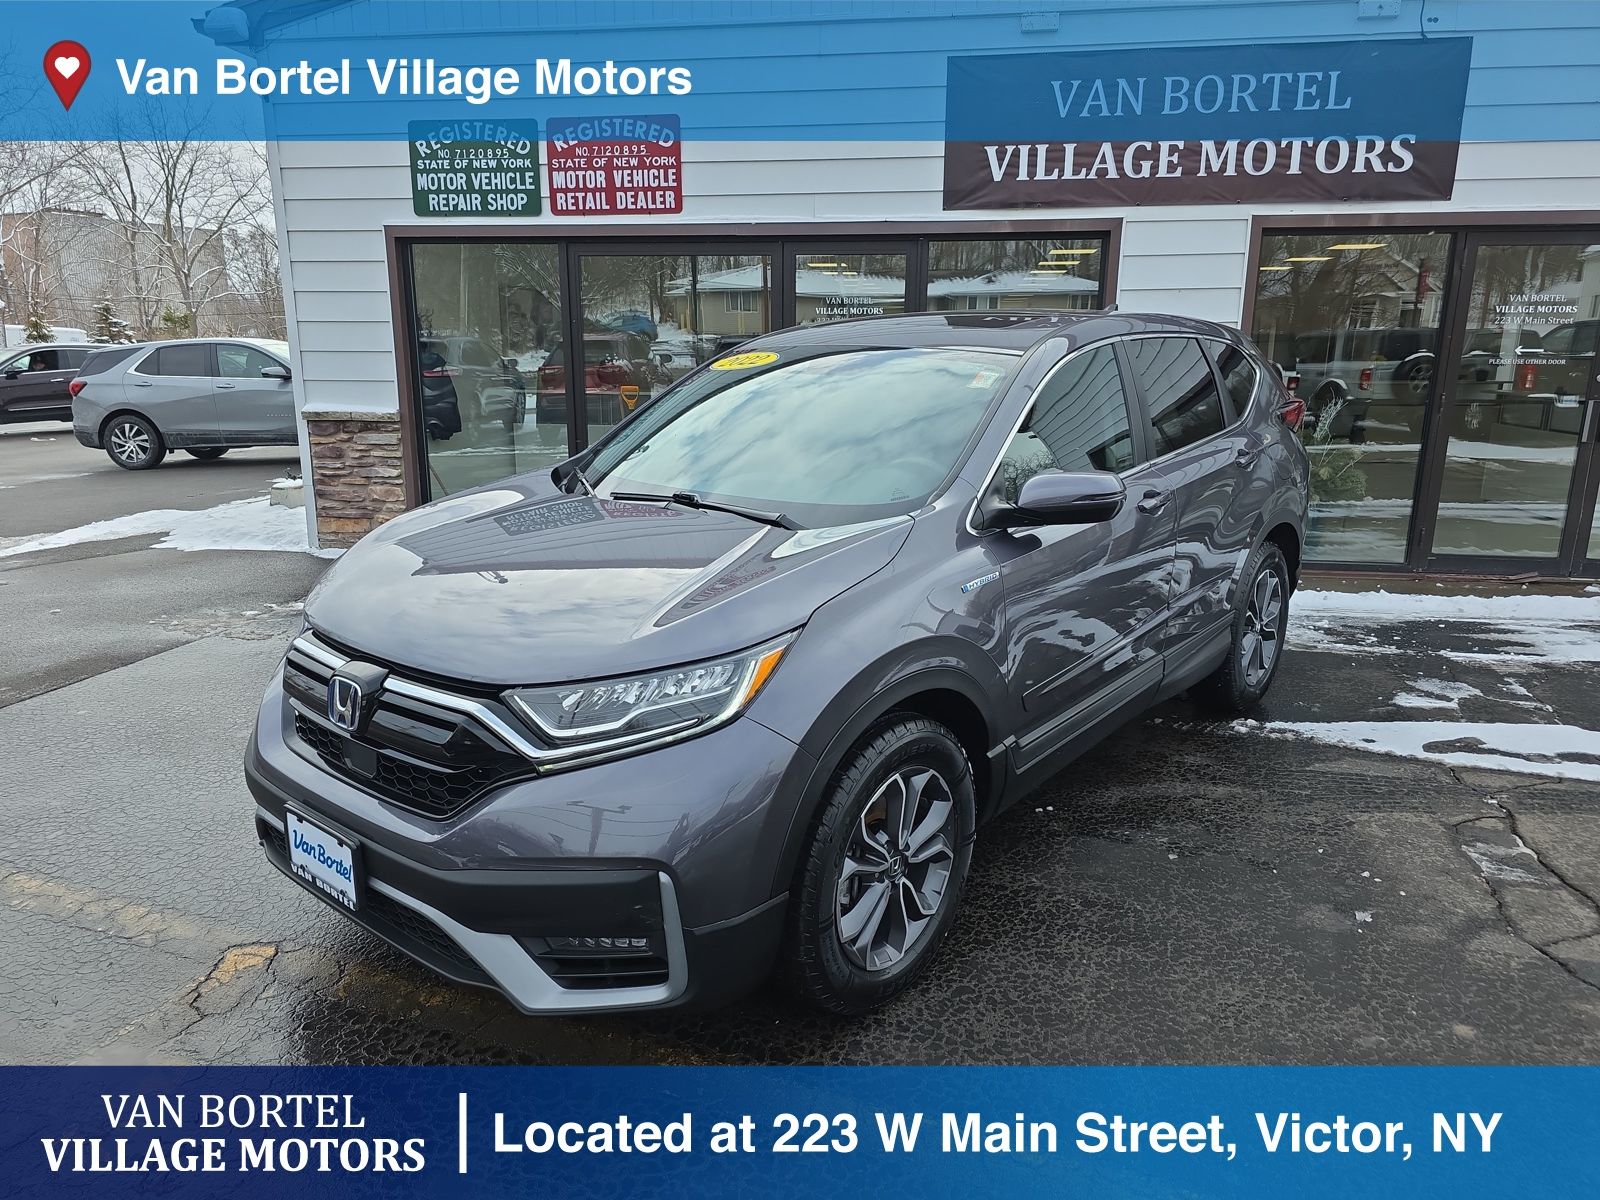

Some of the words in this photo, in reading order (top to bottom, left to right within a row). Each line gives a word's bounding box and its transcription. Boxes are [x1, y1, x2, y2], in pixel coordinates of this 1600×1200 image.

[1051, 77, 1147, 118] VAN
[1161, 71, 1351, 114] BORTEL
[415, 122, 531, 157] REGISTERED
[552, 119, 675, 152] REGISTERED
[438, 149, 451, 158] NO.
[455, 148, 510, 158] 7120895
[575, 146, 590, 156] NO.
[592, 145, 647, 155] 7120895
[984, 140, 1184, 182] VILLAGE
[1196, 133, 1416, 177] MOTORS
[417, 160, 450, 169] STATE
[455, 159, 468, 168] OF
[473, 159, 497, 168] NEW
[501, 159, 532, 168] YORK
[552, 159, 588, 168] STATE
[593, 158, 608, 168] OF
[613, 158, 638, 167] NEW
[644, 157, 677, 166] YORK
[417, 173, 467, 190] MOTOR
[471, 172, 535, 190] VEHICLE
[552, 170, 606, 189] MOTOR
[613, 169, 677, 187] VEHICLE
[428, 194, 481, 211] REPAIR
[487, 193, 528, 211] SHOP
[556, 192, 610, 210] RETAIL
[616, 191, 676, 209] DEALER
[826, 296, 841, 304] VAN
[843, 296, 874, 304] BORTEL
[1510, 294, 1529, 302] VAN
[1530, 294, 1567, 302] BORTEL
[815, 307, 848, 315] VILLAGE
[850, 307, 884, 315] MOTORS
[1495, 305, 1535, 313] VILLAGE
[1537, 305, 1578, 313] MOTORS
[1494, 316, 1511, 324] 223
[1513, 316, 1523, 324] W
[1525, 316, 1546, 324] Main
[1547, 316, 1574, 324] Street
[968, 572, 999, 590] HYBRID
